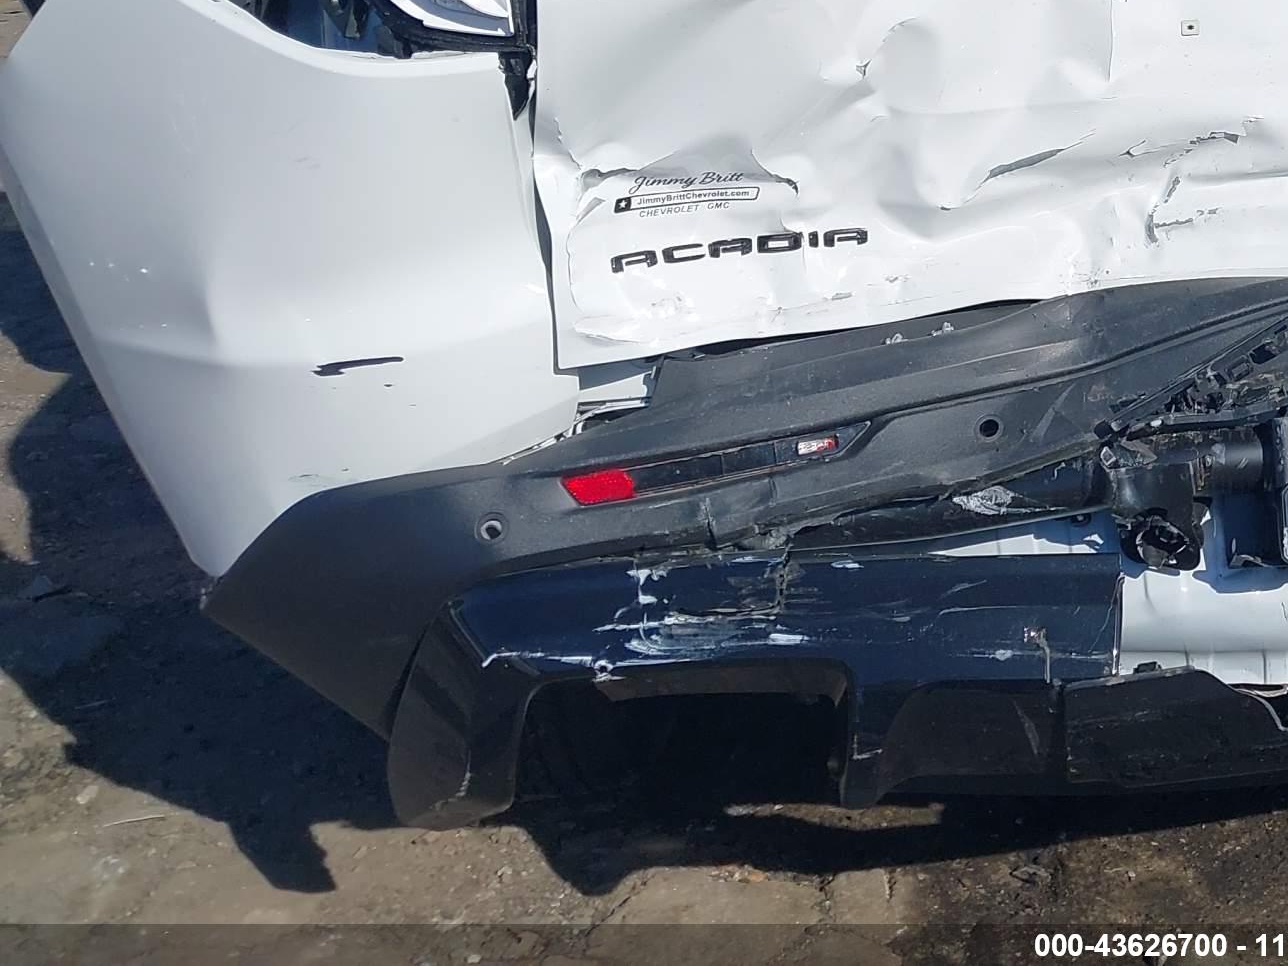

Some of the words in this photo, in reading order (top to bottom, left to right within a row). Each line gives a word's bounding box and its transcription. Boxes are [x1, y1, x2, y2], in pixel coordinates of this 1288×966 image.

[629, 175, 698, 194] Jimmy
[699, 171, 745, 185] Britt
[637, 190, 750, 205] JimmyBrittChevrolet.com
[639, 204, 700, 218] CHEVROLET
[707, 201, 730, 210] GMC
[610, 228, 869, 274] ACADIA
